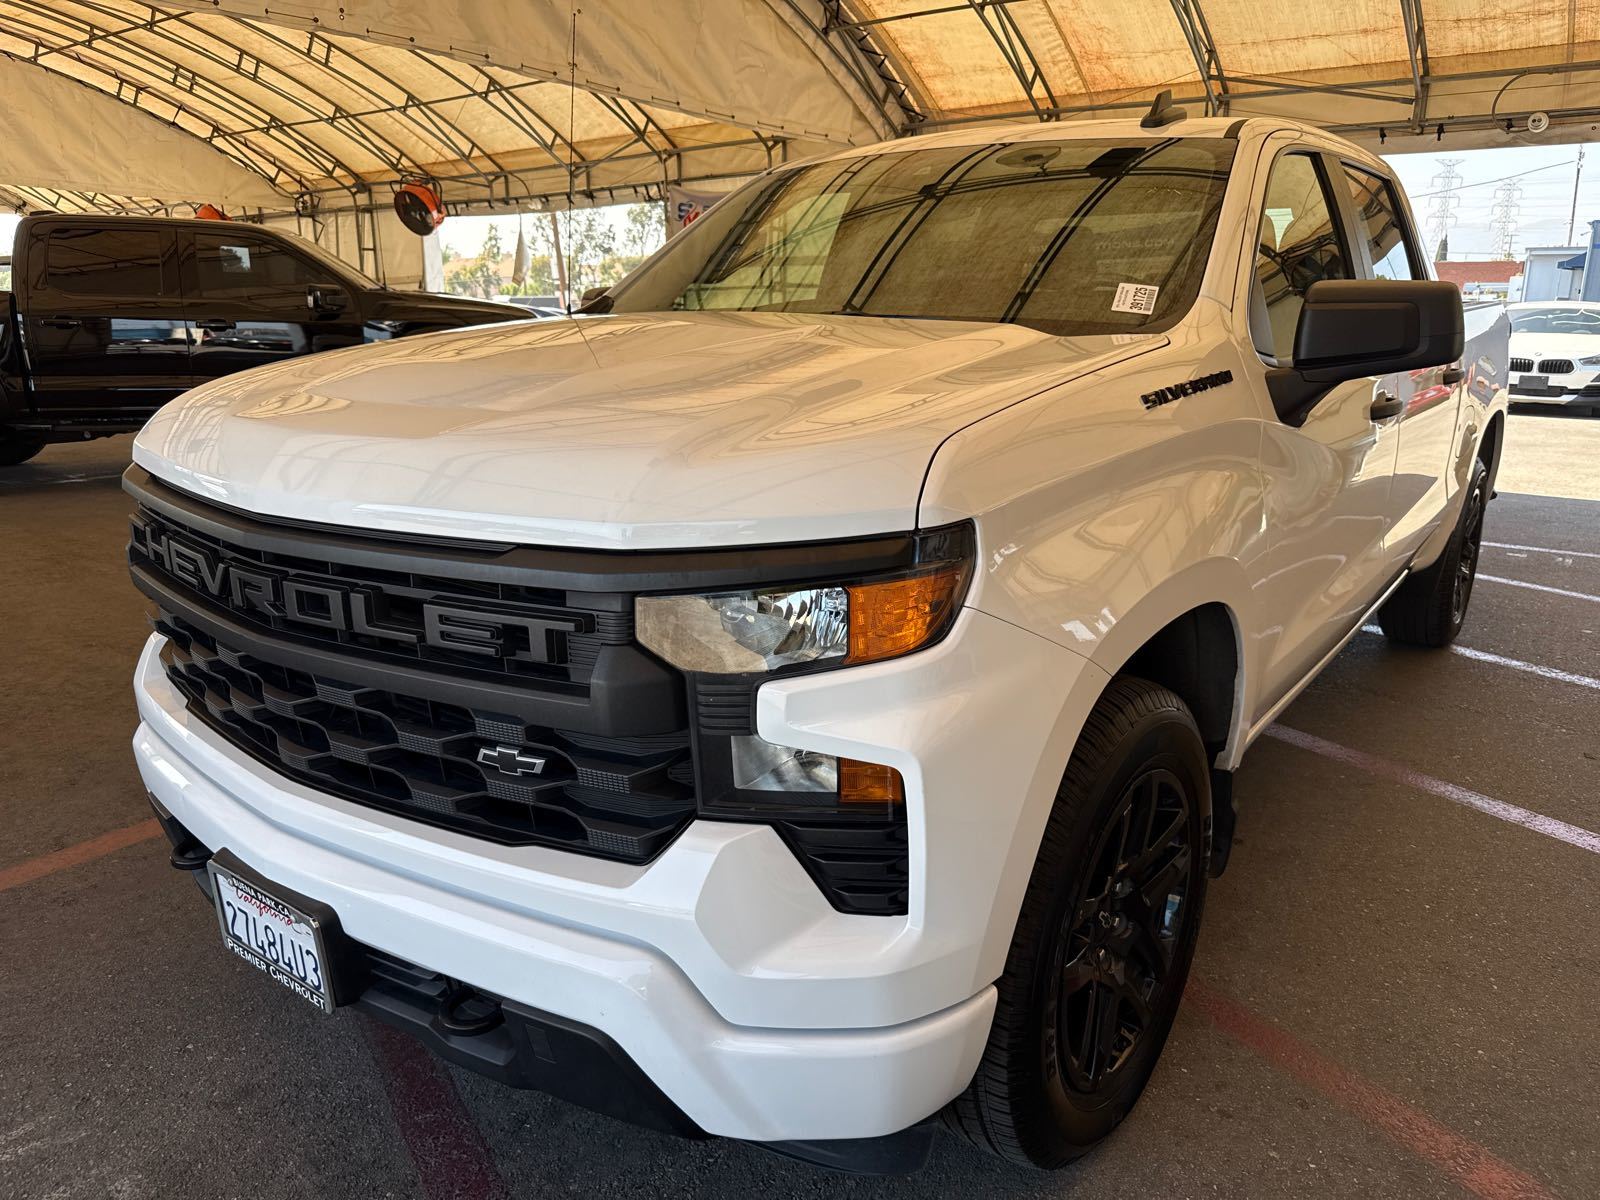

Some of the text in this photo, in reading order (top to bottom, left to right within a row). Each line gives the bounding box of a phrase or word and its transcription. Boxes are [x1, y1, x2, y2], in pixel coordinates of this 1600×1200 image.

[1129, 286, 1148, 311] 391725
[127, 512, 594, 665] CHEVROLET
[226, 900, 322, 992] 27484U3
[227, 938, 326, 1010] PREMIER CHEVROLET
